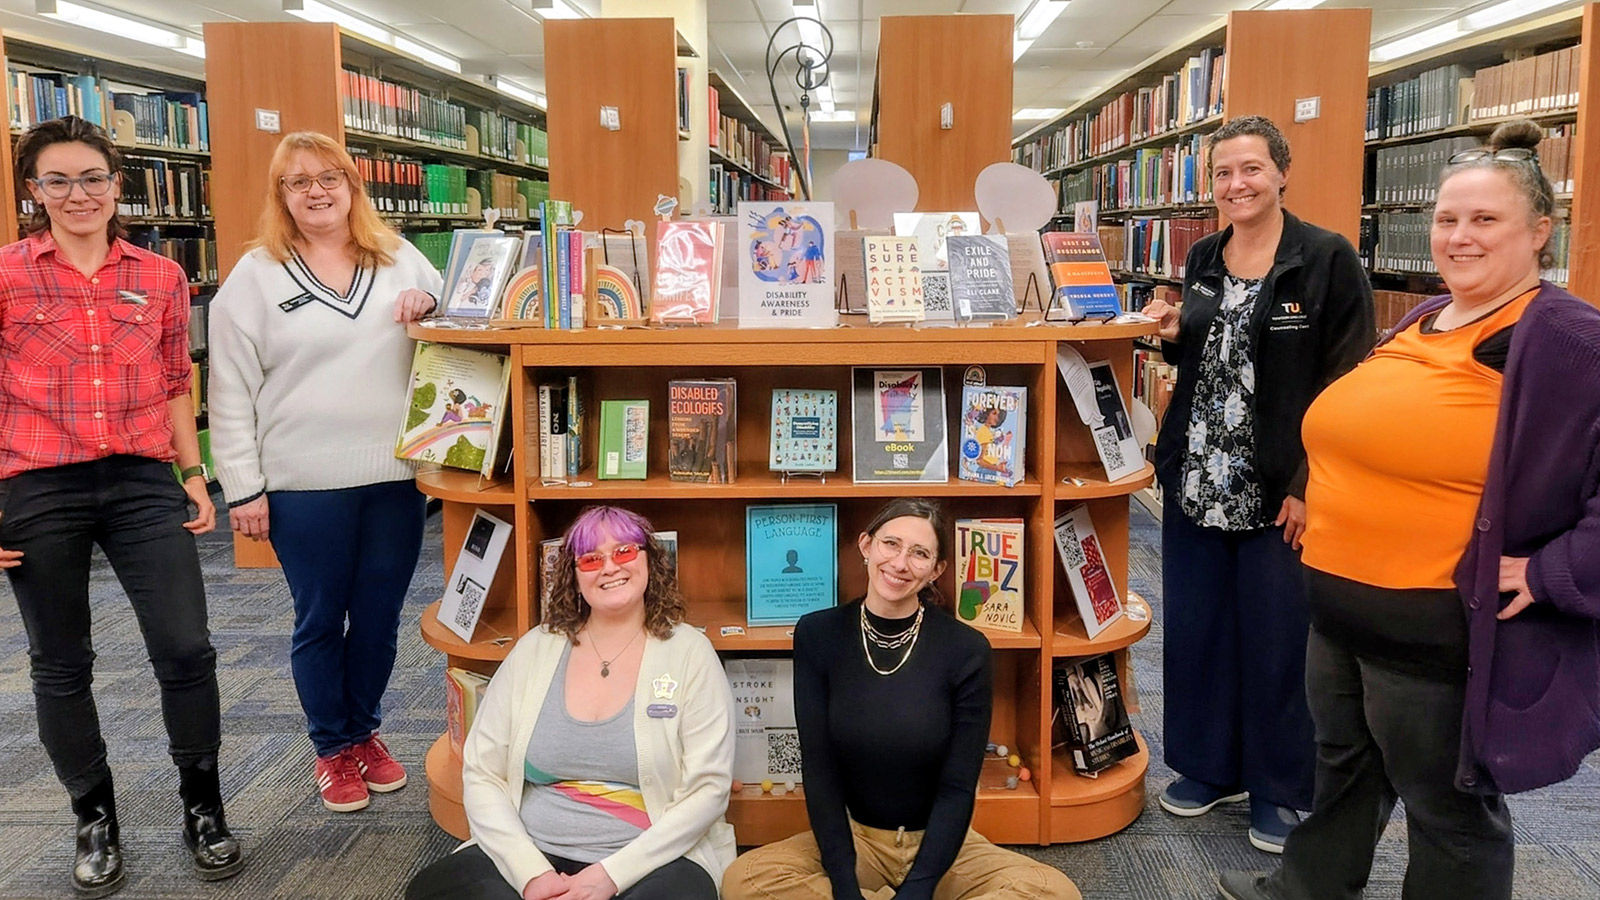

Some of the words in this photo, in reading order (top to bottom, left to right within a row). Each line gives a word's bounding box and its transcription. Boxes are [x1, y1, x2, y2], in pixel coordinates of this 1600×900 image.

[965, 246, 993, 256] EXILE
[970, 258, 989, 267] AND
[966, 268, 996, 278] PRIDE
[766, 291, 807, 299] DISABILITY
[761, 300, 810, 308] AWARENESS
[1281, 302, 1300, 313] TU
[671, 387, 718, 401] DISABLED
[671, 401, 724, 415] ECOLOGIES
[966, 391, 1015, 412] FOREVER
[553, 413, 560, 433] NO
[885, 442, 915, 452] eBook
[987, 444, 1012, 460] NOW
[754, 513, 829, 529] PERSON-FIRST
[764, 526, 822, 540] LANGUAGE
[958, 527, 1018, 560] TRUE
[977, 556, 1018, 593] BIZ
[983, 602, 1008, 613] SARA
